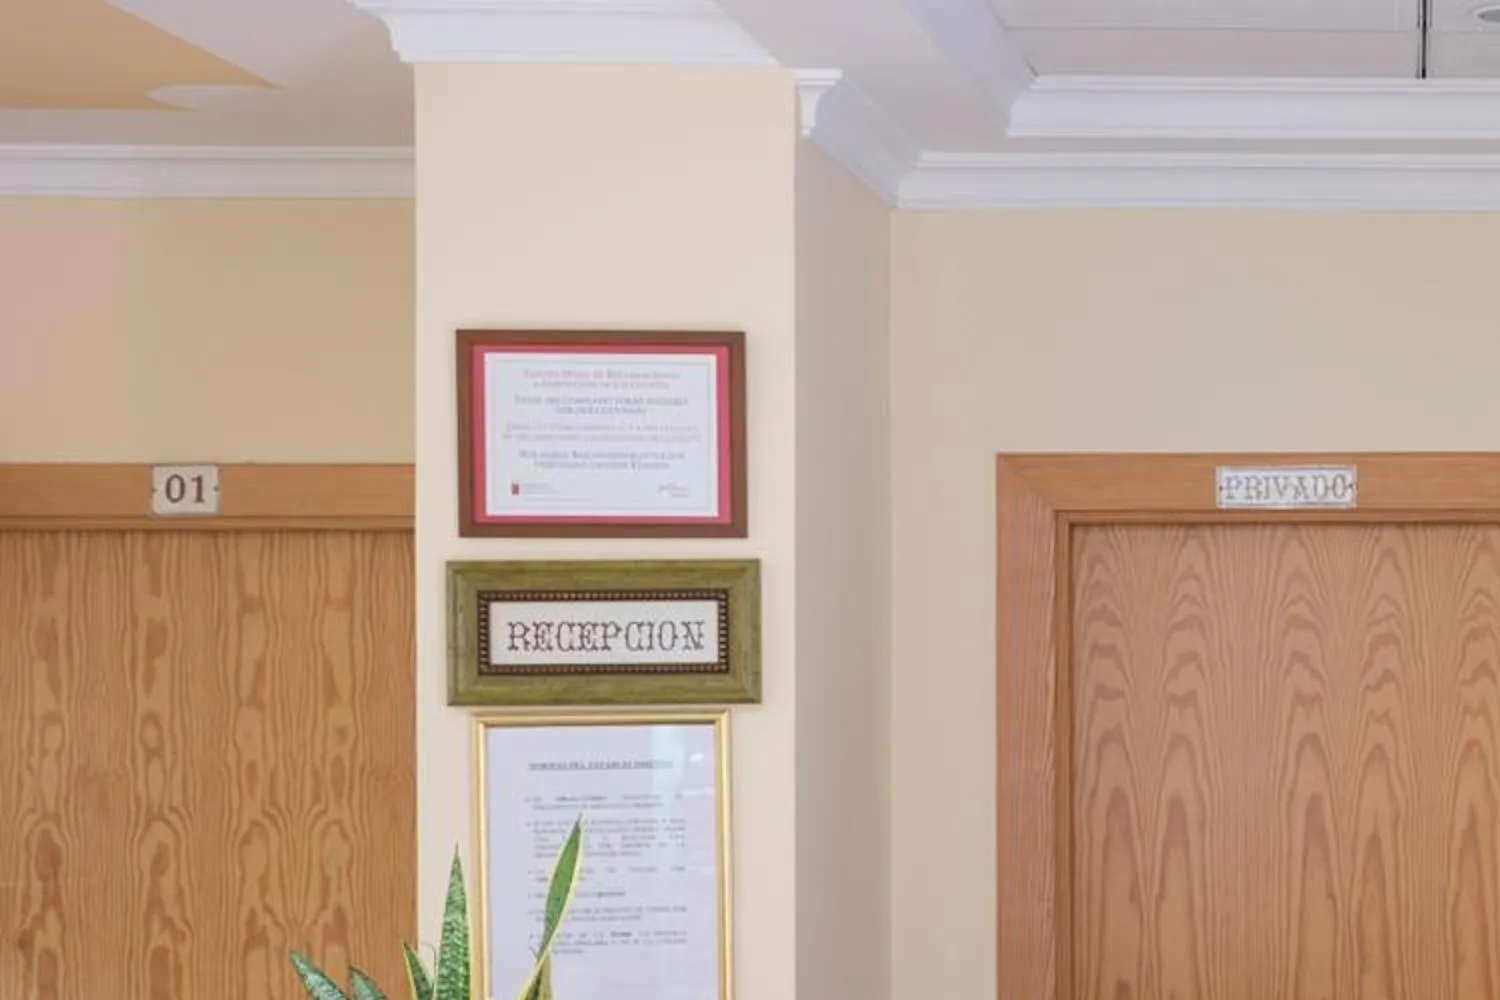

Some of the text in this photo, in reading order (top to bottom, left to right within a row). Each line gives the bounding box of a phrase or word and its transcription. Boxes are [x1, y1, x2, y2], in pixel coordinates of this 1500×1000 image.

[165, 473, 206, 504] 01
[1224, 473, 1348, 500] PRIVADO
[507, 620, 705, 652] RECEPCION
